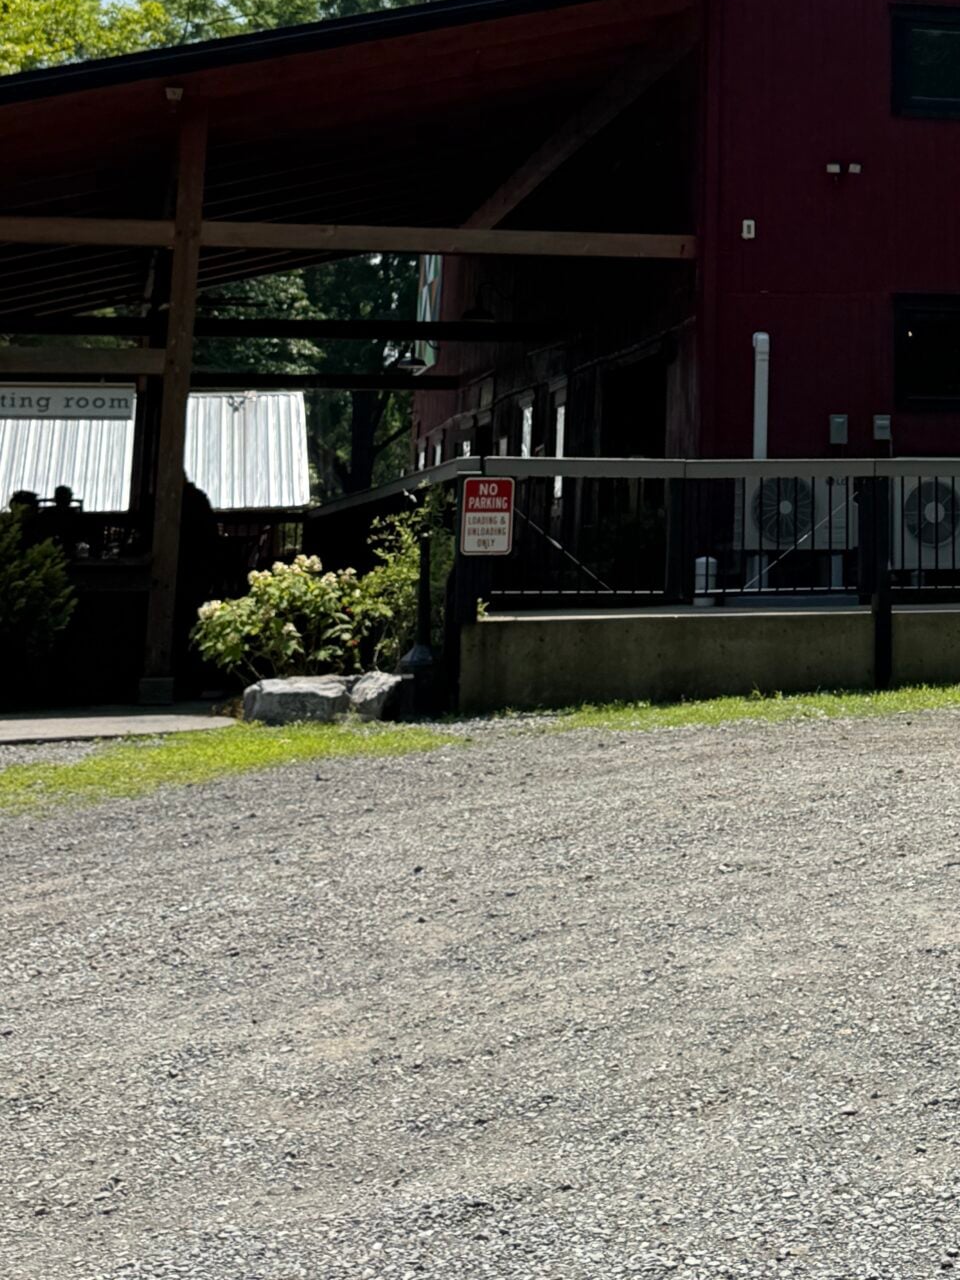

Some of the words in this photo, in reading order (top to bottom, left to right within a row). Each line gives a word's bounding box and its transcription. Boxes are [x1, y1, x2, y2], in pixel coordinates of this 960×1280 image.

[63, 396, 129, 408] room
[479, 483, 498, 495] NO
[468, 497, 508, 509] PARKING
[468, 516, 498, 525] LOADING
[500, 516, 506, 525] &
[467, 527, 506, 536] UNLOADING
[477, 538, 495, 547] ONLY
